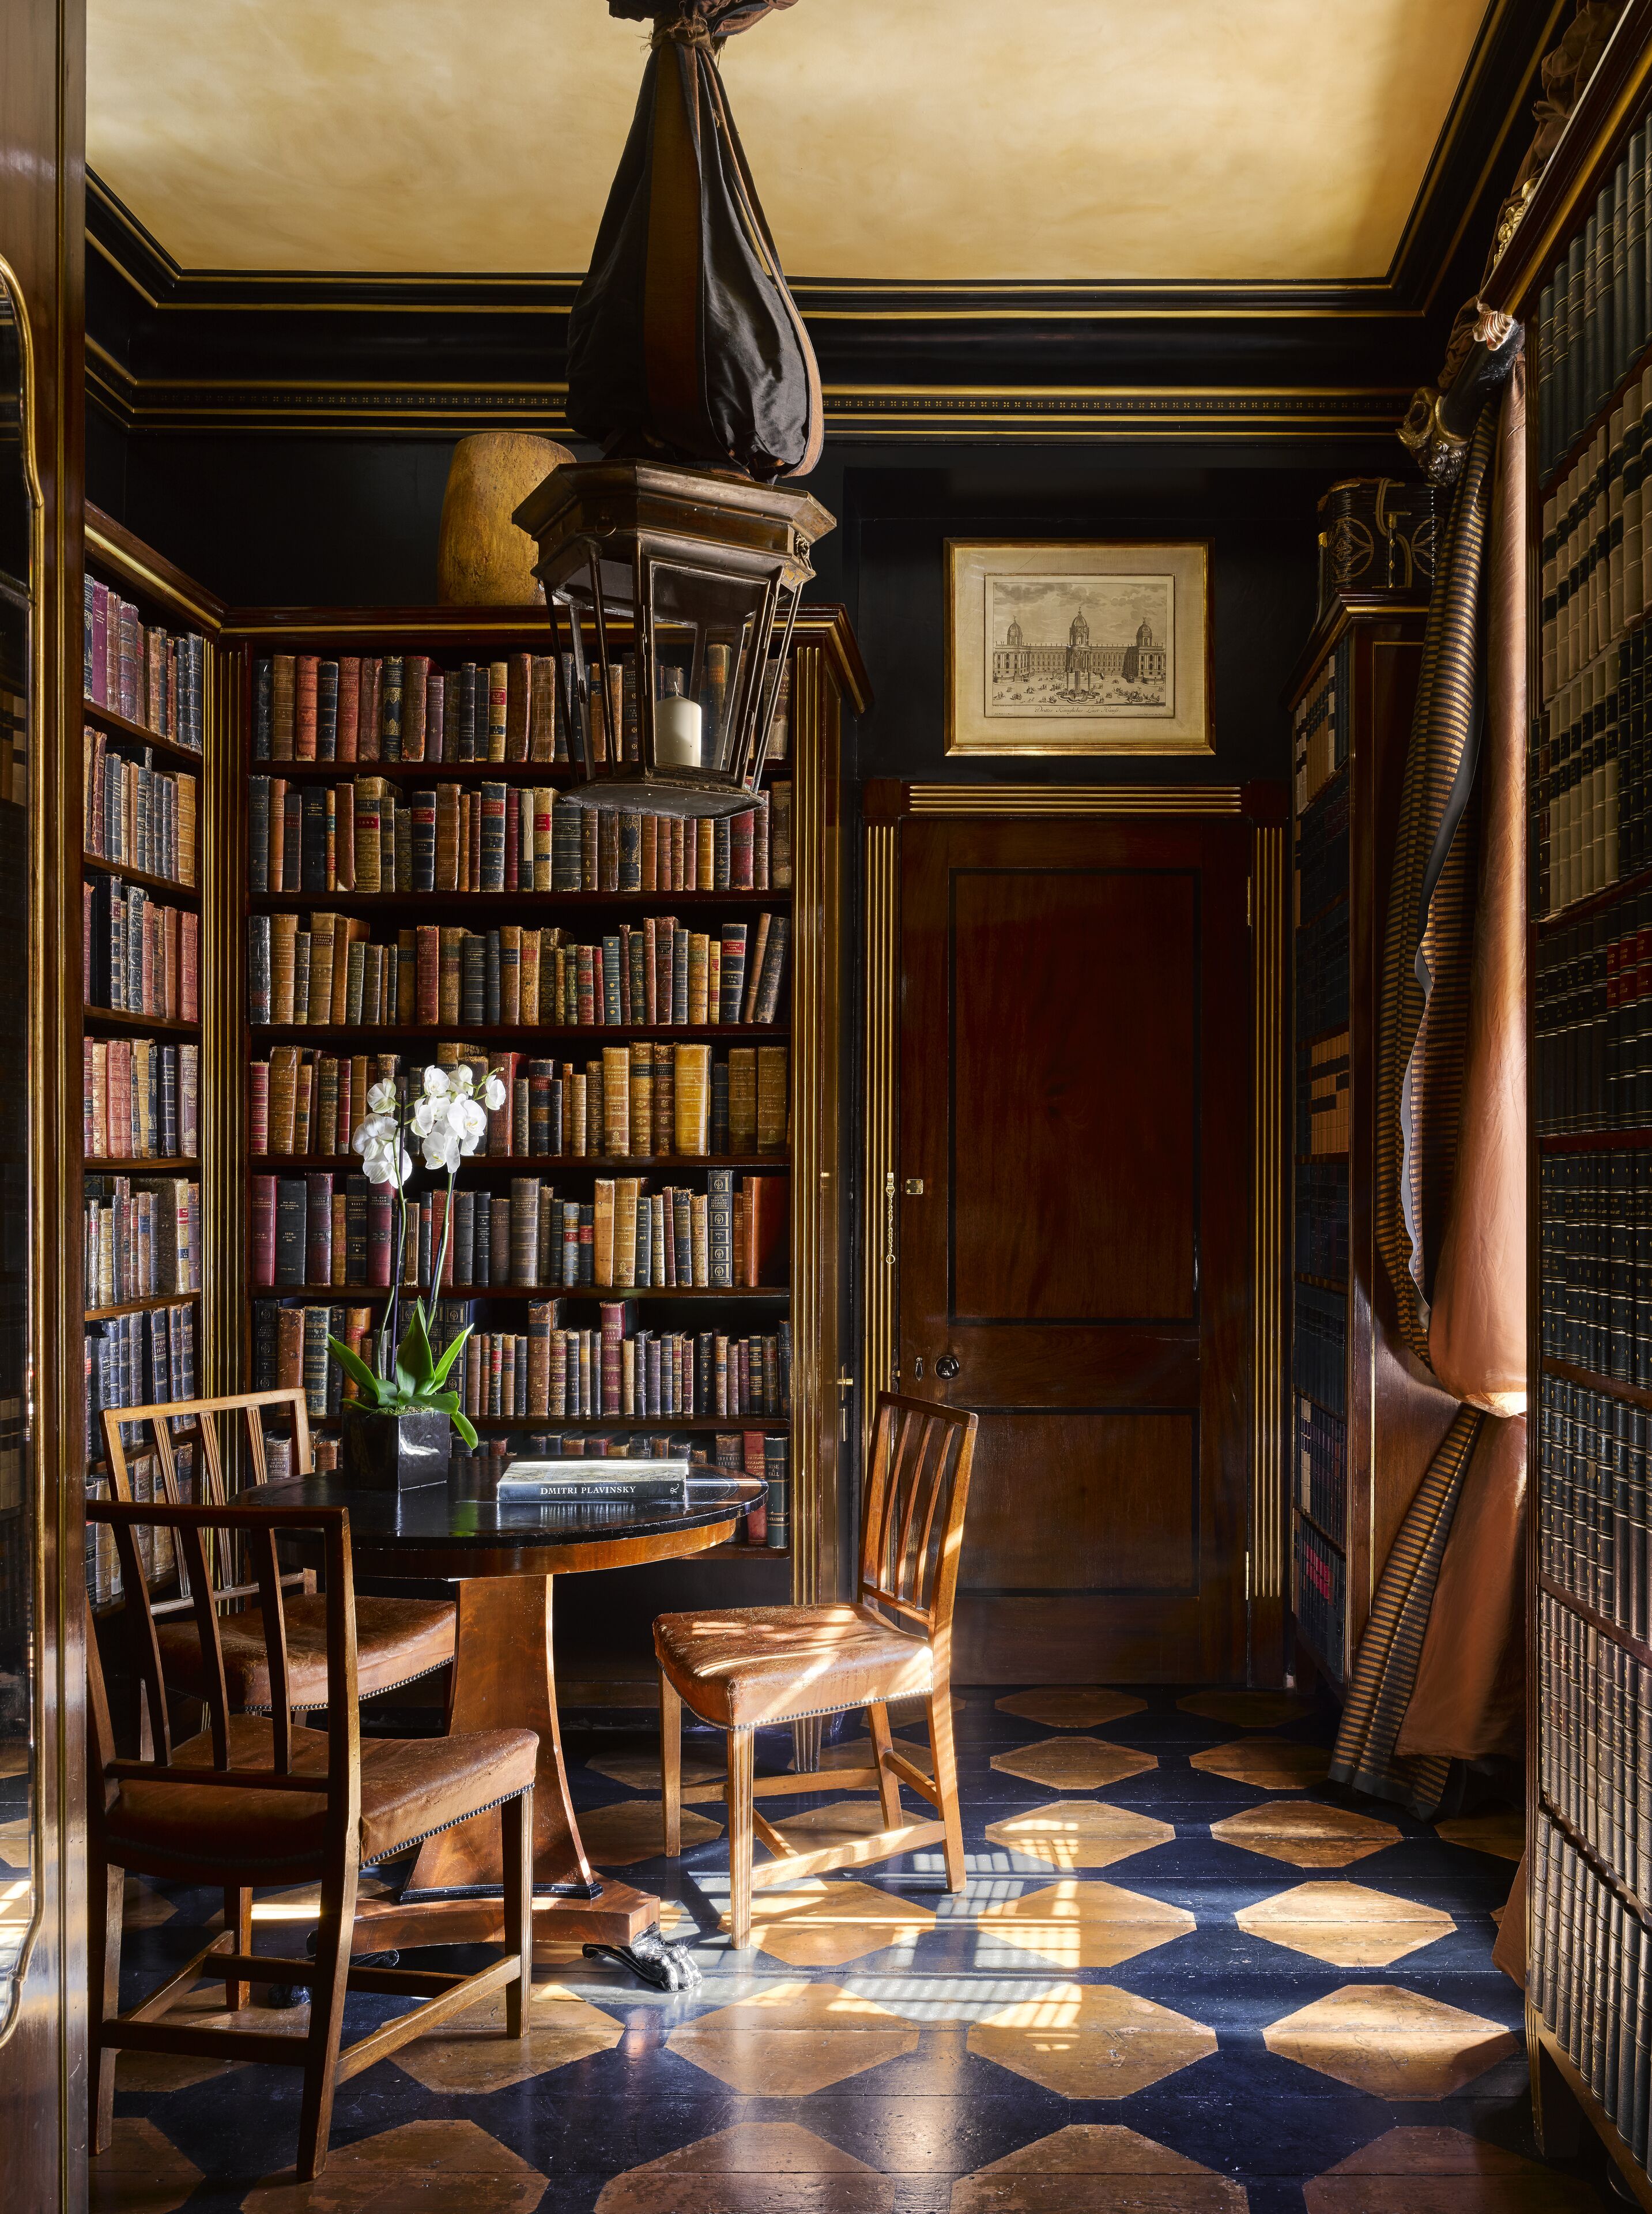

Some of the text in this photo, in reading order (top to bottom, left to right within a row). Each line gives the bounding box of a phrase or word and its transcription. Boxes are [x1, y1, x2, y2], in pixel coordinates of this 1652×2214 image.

[155, 1339, 166, 1347] PUNC
[540, 1486, 636, 1494] DMITRI PLAVINSKY
